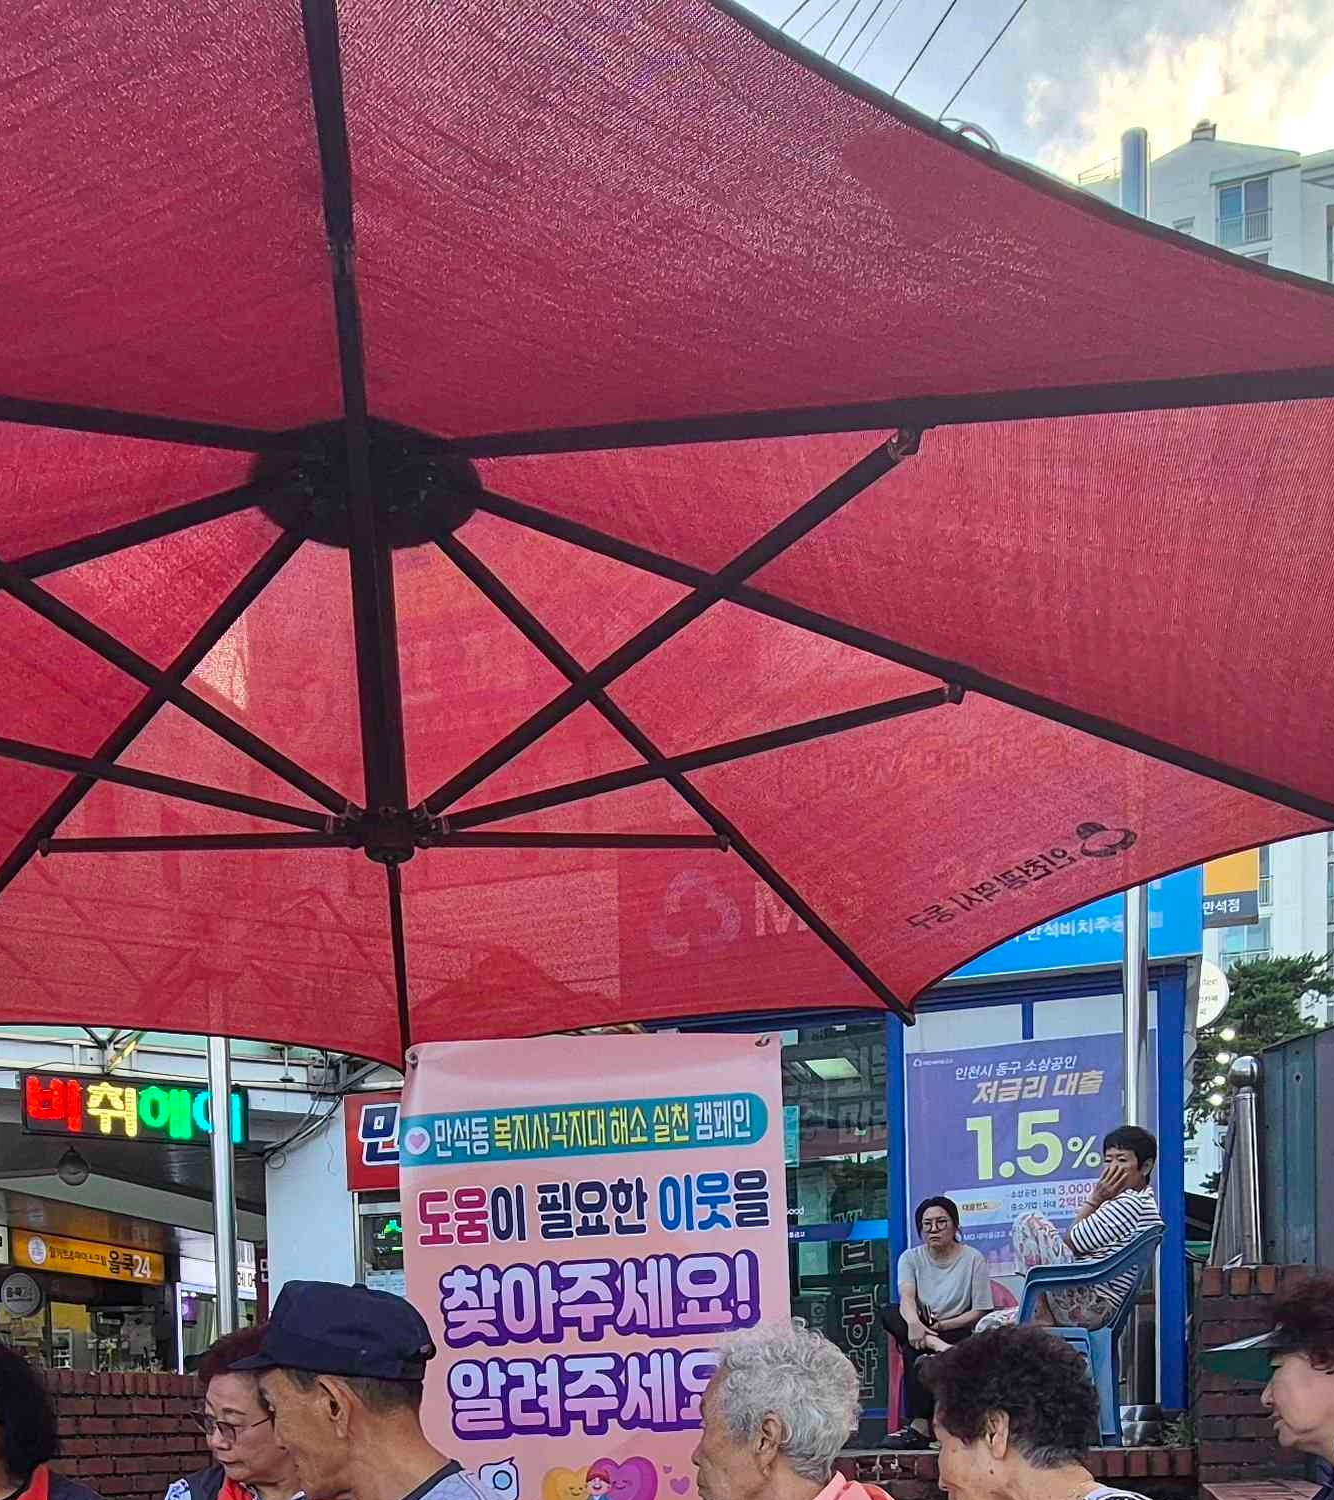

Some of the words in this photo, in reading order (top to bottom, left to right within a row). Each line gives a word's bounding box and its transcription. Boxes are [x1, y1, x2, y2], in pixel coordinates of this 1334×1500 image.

[955, 1064, 994, 1081] 인천시
[996, 1061, 1020, 1077] 동구
[1024, 1055, 1078, 1073] 소상공인
[972, 1076, 1047, 1105] 저금리
[1051, 1070, 1105, 1097] 대출
[434, 1117, 490, 1157] 만석동
[493, 1108, 607, 1153] 복지사각지대
[609, 1106, 648, 1146] 해소
[652, 1102, 690, 1144] 실천
[693, 1098, 752, 1141] 캠페인
[966, 1108, 1101, 1182] 1.5%
[417, 1183, 528, 1247] 도움이
[536, 1175, 649, 1241] 필요한
[658, 1168, 771, 1233] 이웃을
[1058, 1181, 1100, 1196] 3,000
[440, 1251, 759, 1347] 찾아주세요!
